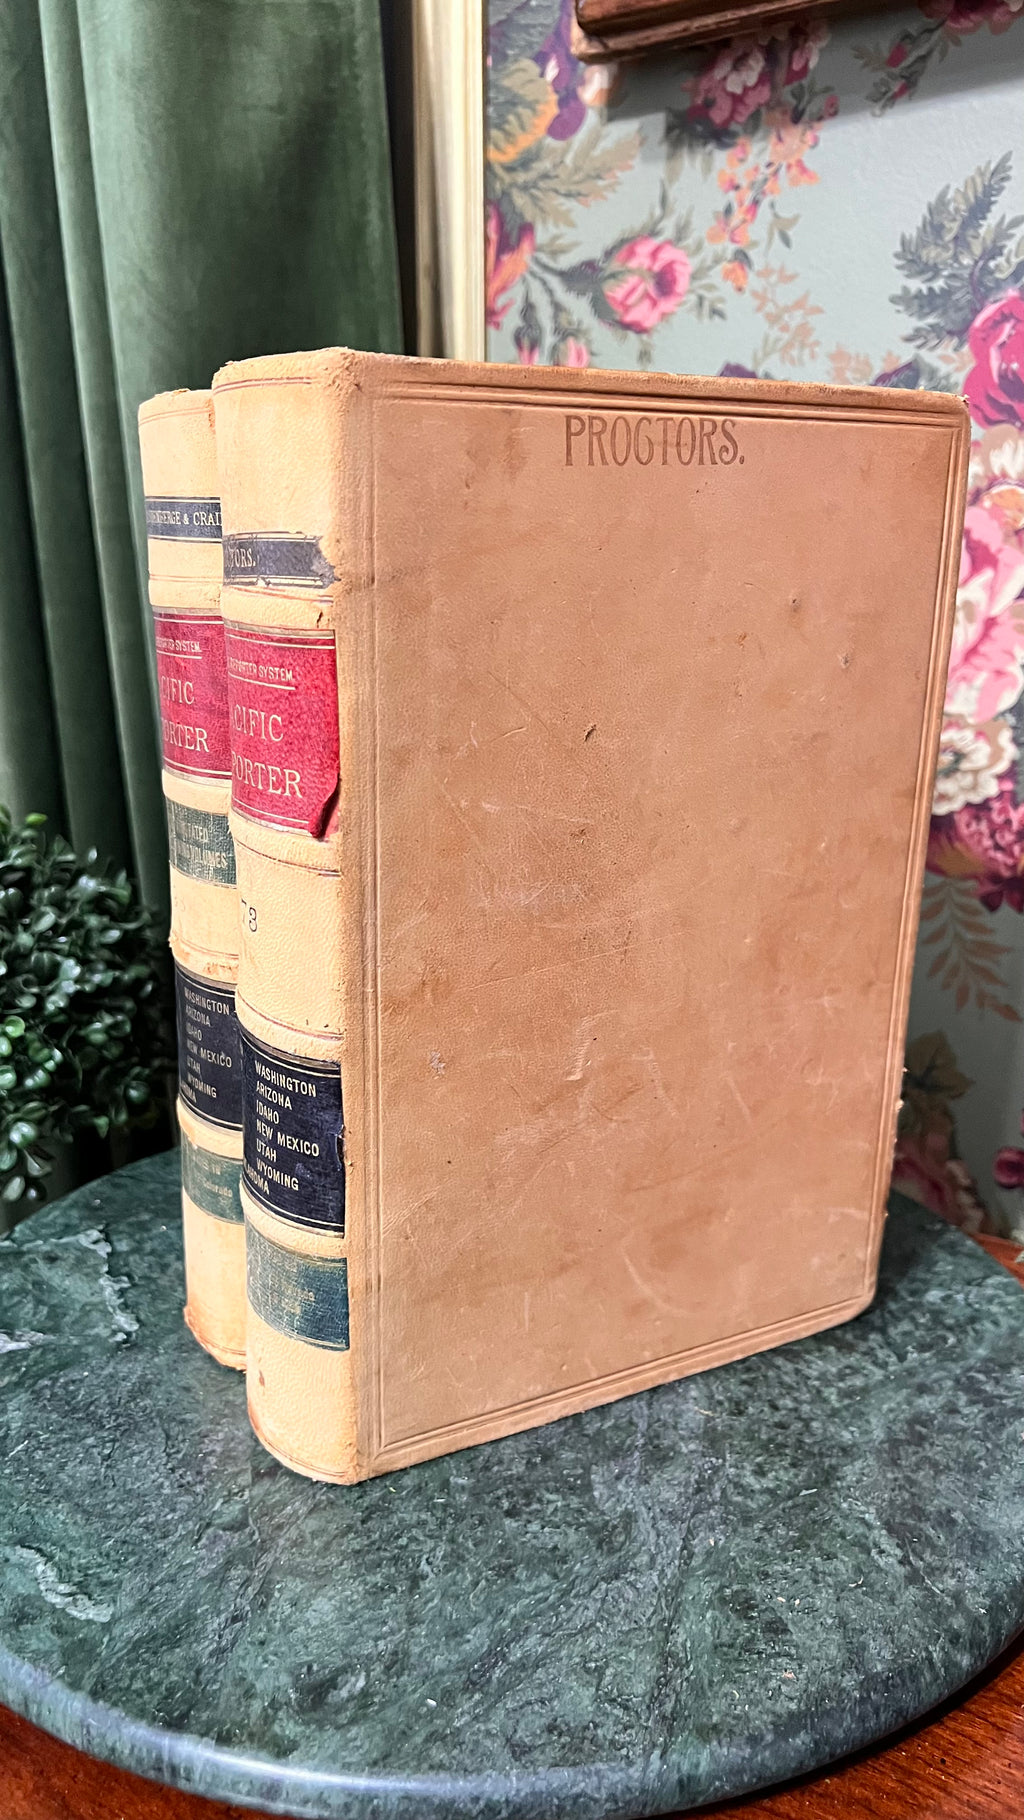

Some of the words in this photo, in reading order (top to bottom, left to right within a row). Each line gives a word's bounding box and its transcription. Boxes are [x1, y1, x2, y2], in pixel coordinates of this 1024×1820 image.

[183, 513, 189, 525] &
[193, 511, 223, 527] CRAI
[184, 986, 230, 1016] WASHINGTON
[200, 1047, 233, 1068] MEXICO
[187, 1071, 217, 1099] WYOMING
[255, 1060, 317, 1098] WASHINGTON
[256, 1080, 292, 1111] ARIZONA
[256, 1099, 280, 1124] IDAHO
[256, 1118, 274, 1140] NEW
[277, 1131, 320, 1157] MEXICO
[256, 1138, 277, 1163] UTAH
[256, 1157, 299, 1191] WYOMING
